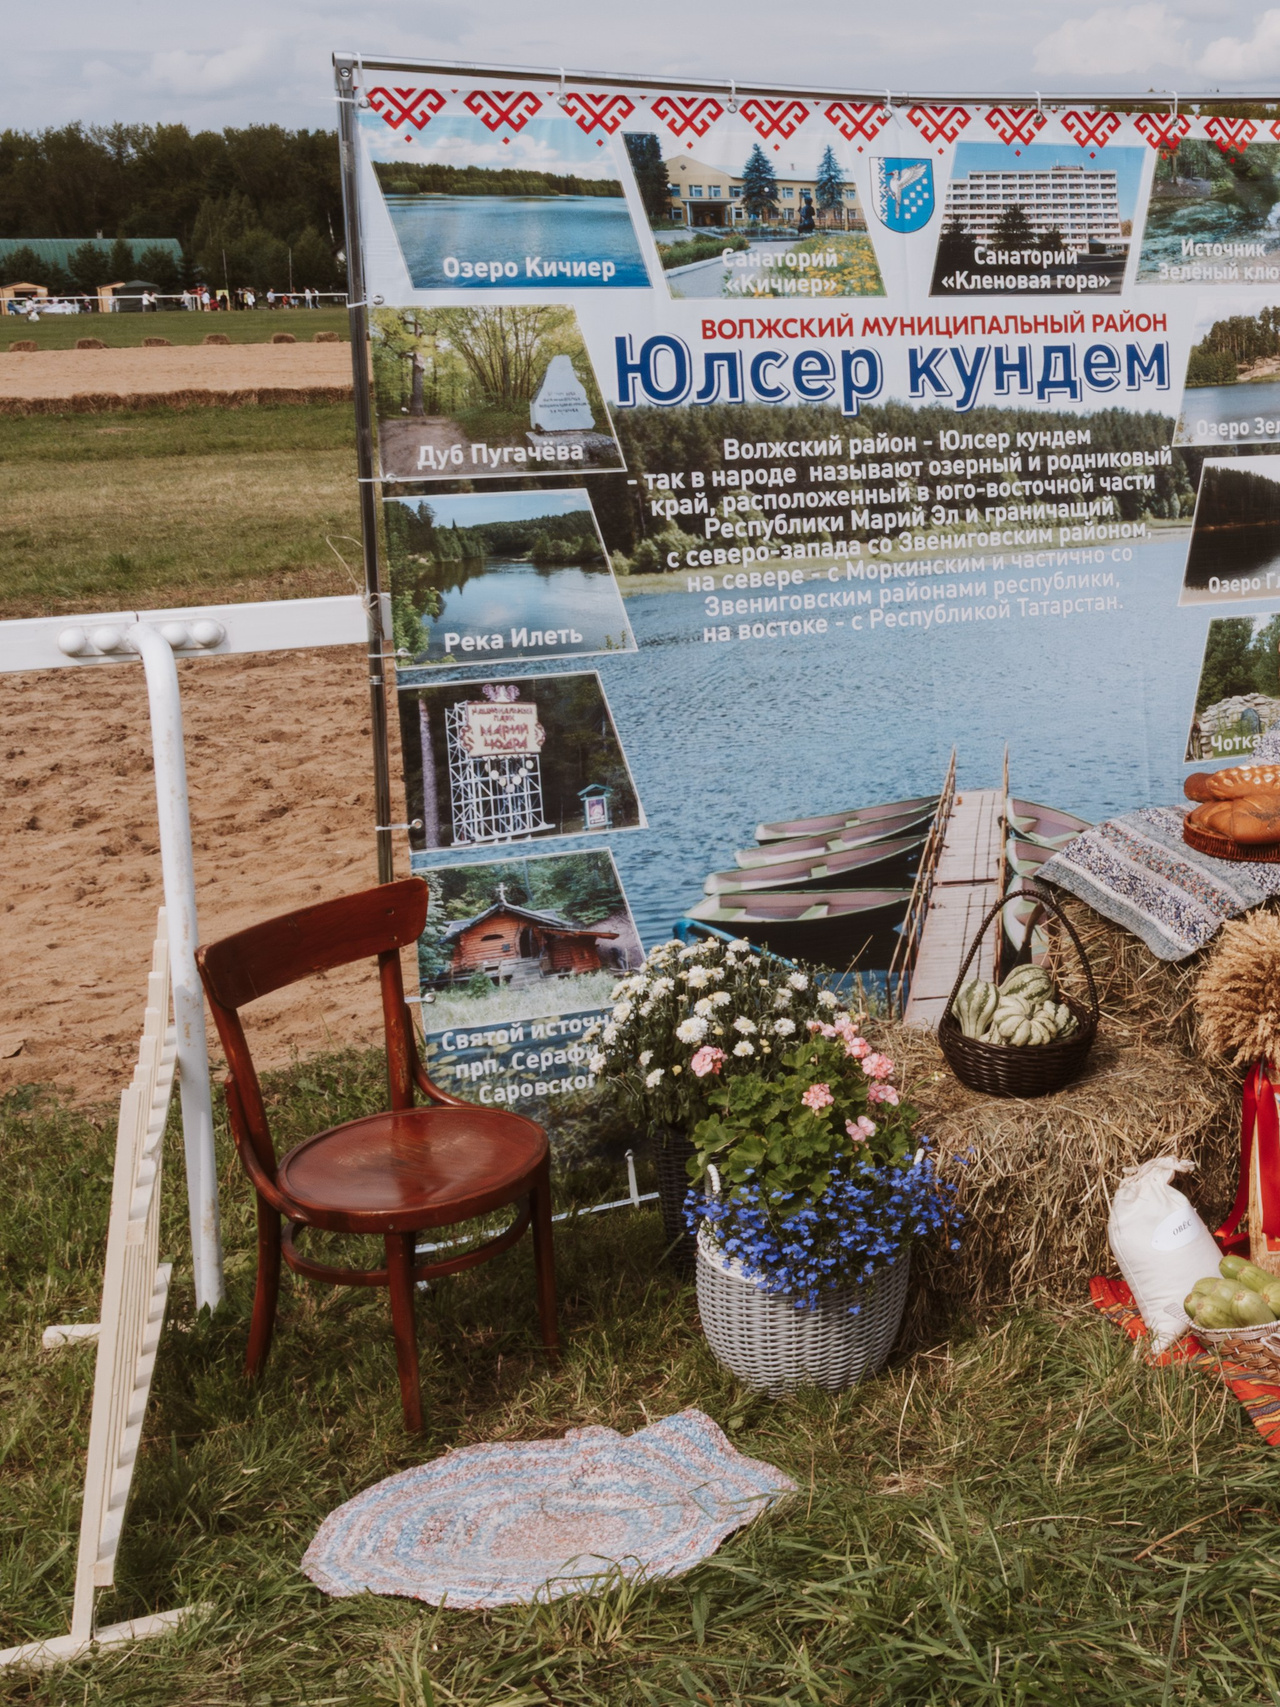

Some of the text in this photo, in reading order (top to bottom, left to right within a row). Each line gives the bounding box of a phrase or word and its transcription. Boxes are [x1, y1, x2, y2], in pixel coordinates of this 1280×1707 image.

[722, 247, 838, 272] Санаторий
[974, 246, 1078, 268] Санаторий
[1181, 238, 1267, 257] Источник
[443, 256, 616, 282] Озеро Кичиер
[941, 270, 1112, 293] «Кленовая гора»
[1158, 262, 1239, 280] Зелёный
[725, 274, 838, 297] «Кичиер»
[701, 310, 1167, 340] ВОЛЖСКИЙ МУНИЦИПАЛЬНЫЙ РАЙОН
[614, 333, 1170, 417] Юлсер кундем
[1197, 419, 1250, 439] Озеро
[417, 441, 584, 470] Дуб Пугачёва
[723, 434, 842, 460] Волжский
[849, 433, 916, 459] район
[939, 429, 1010, 452] Юлсер
[1016, 429, 1091, 452] кундем
[643, 471, 685, 490] так
[691, 471, 705, 488] в
[712, 465, 797, 491] народе
[809, 460, 923, 482] называют
[928, 452, 1022, 479] озерный
[1029, 455, 1041, 471] и
[1047, 445, 1172, 474] родниковый
[651, 474, 1156, 520] край, расположенный в юго-восточной части
[704, 497, 1114, 541] Республики Марий Эл и граничащий
[667, 522, 1152, 568] с северо-запада со Звениговским районом,
[687, 574, 715, 592] на
[722, 568, 804, 591] севере
[827, 566, 840, 582] с
[846, 557, 985, 582] Моркинским
[992, 555, 1004, 571] и
[1011, 548, 1105, 570] частично
[1111, 547, 1133, 563] со
[705, 572, 1121, 617] Звениговским районами республики,
[1208, 576, 1261, 595] Озеро
[703, 625, 731, 643] на
[738, 616, 828, 640] востоке
[851, 615, 863, 631] с
[869, 599, 1010, 630] Республикой
[1016, 595, 1124, 618] Татарстан.
[444, 627, 583, 653] Река Илеть
[442, 1014, 612, 1051] Святой источн
[455, 1058, 506, 1081] прп.
